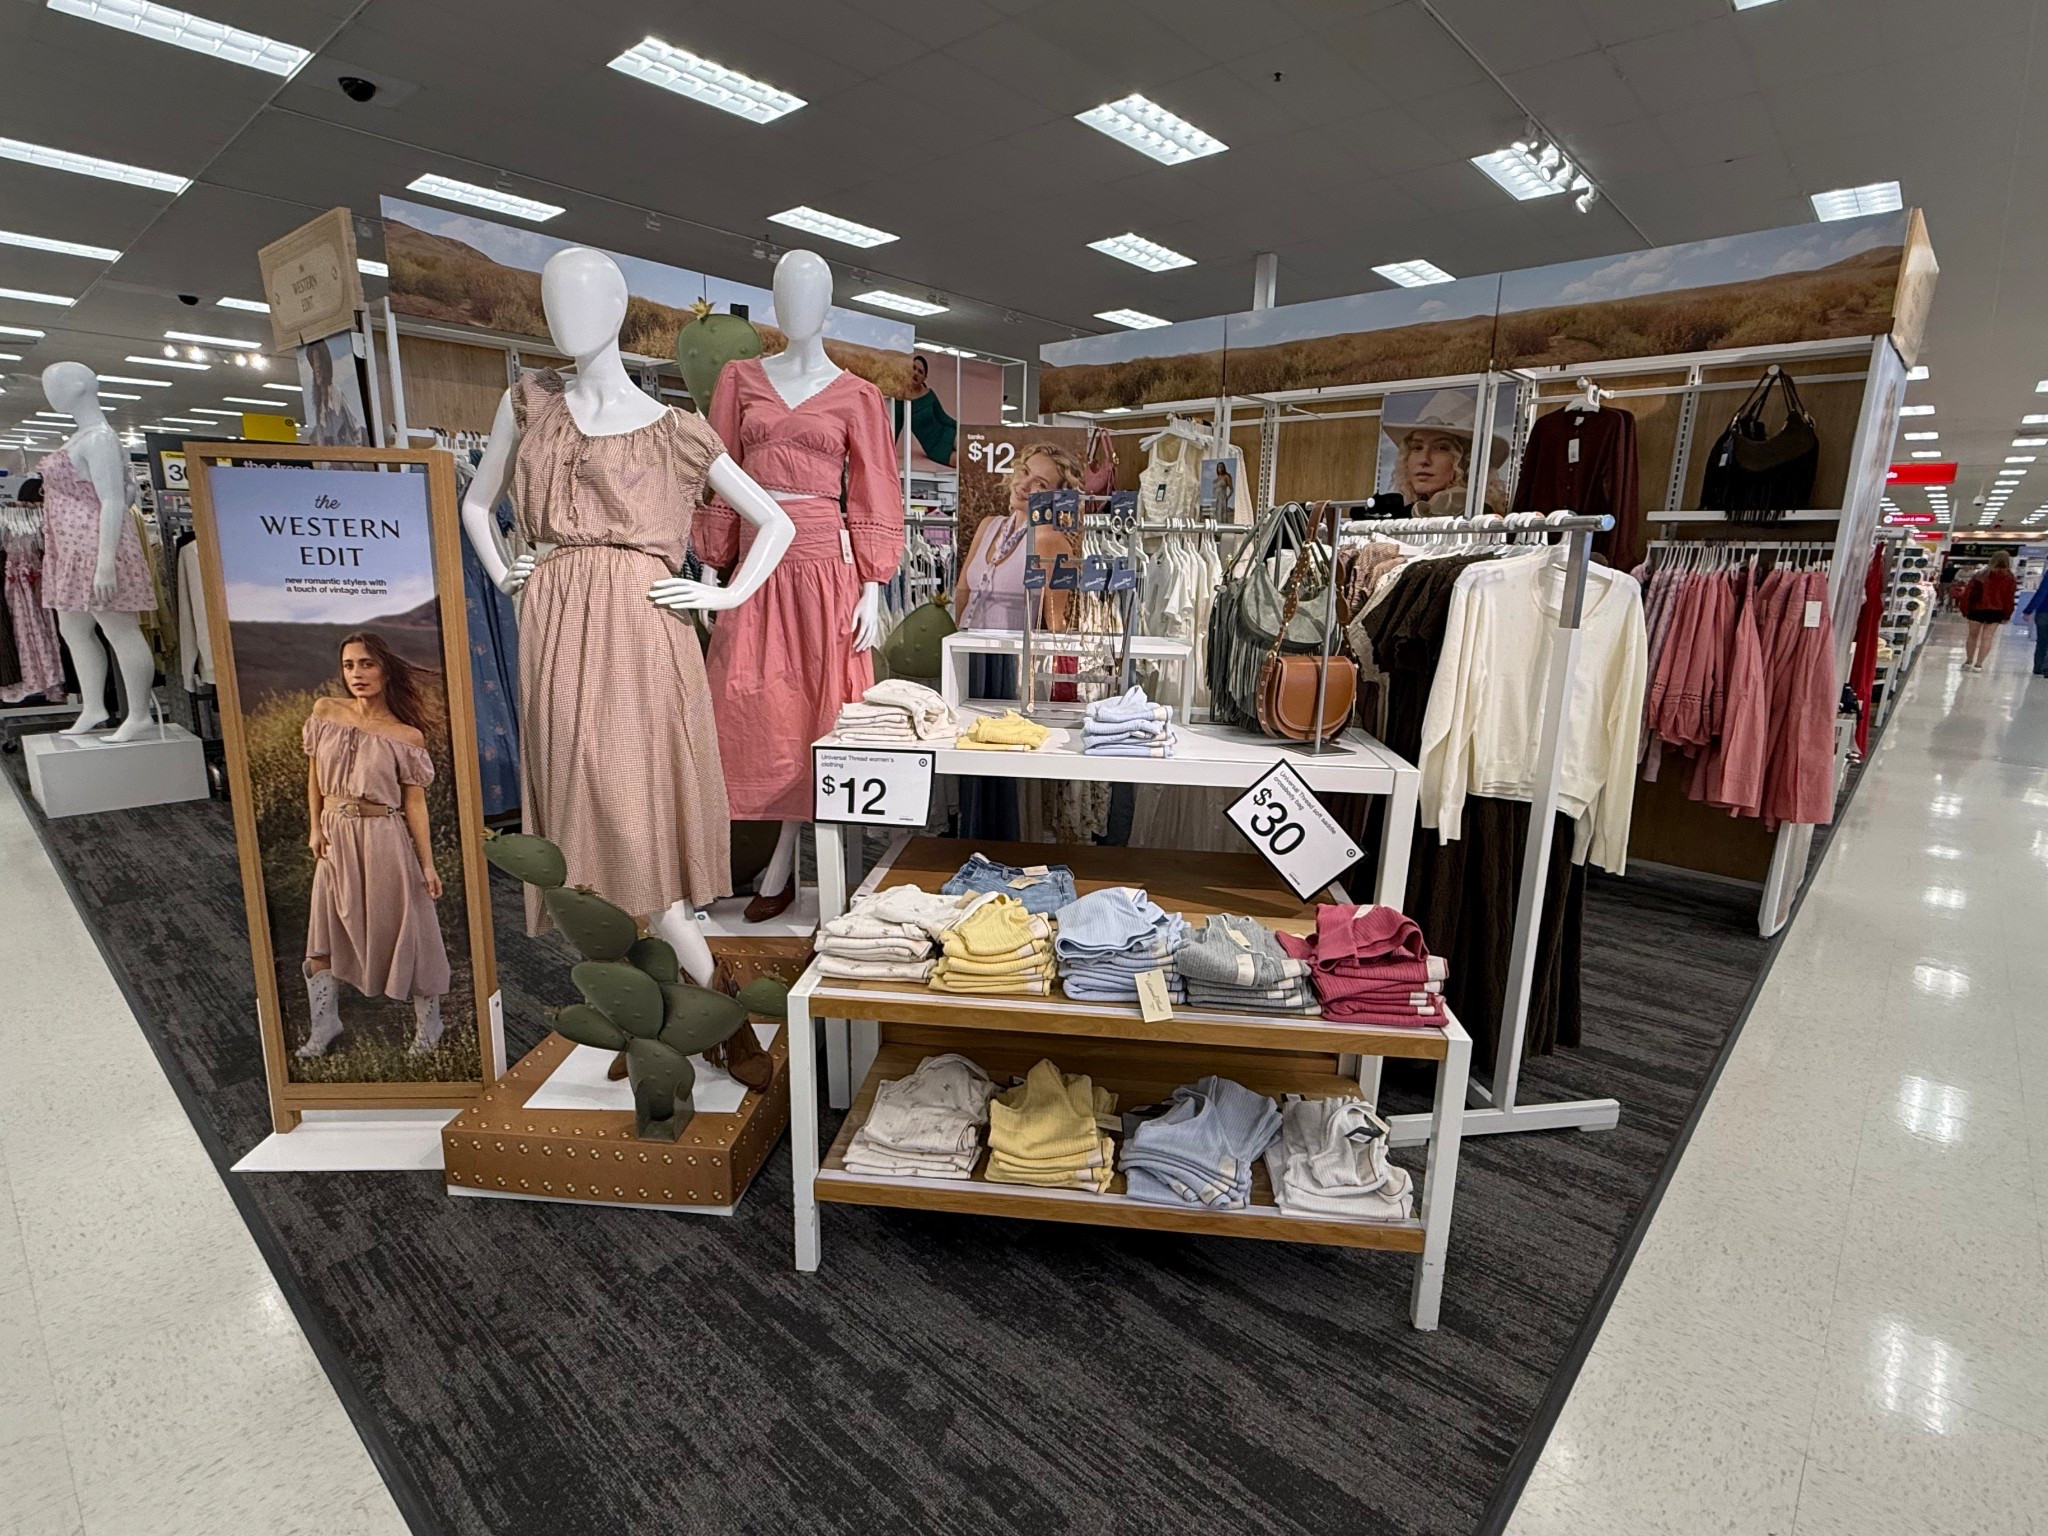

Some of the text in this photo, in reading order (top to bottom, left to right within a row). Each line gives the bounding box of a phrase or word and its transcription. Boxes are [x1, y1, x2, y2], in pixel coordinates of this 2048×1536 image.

[968, 440, 1015, 474] $12
[315, 494, 341, 510] the
[259, 515, 401, 540] WESTERN
[300, 546, 364, 567] EDIT
[293, 585, 317, 593] touch
[329, 586, 359, 595] vintage
[361, 587, 388, 595] charm
[304, 577, 341, 585] romantic
[342, 578, 367, 587] styles
[368, 579, 387, 587] with
[822, 774, 887, 816] $12
[1273, 776, 1305, 811] crossbody bag
[1280, 770, 1336, 835] Universal Thread soft saddle
[1250, 788, 1306, 856] $30
